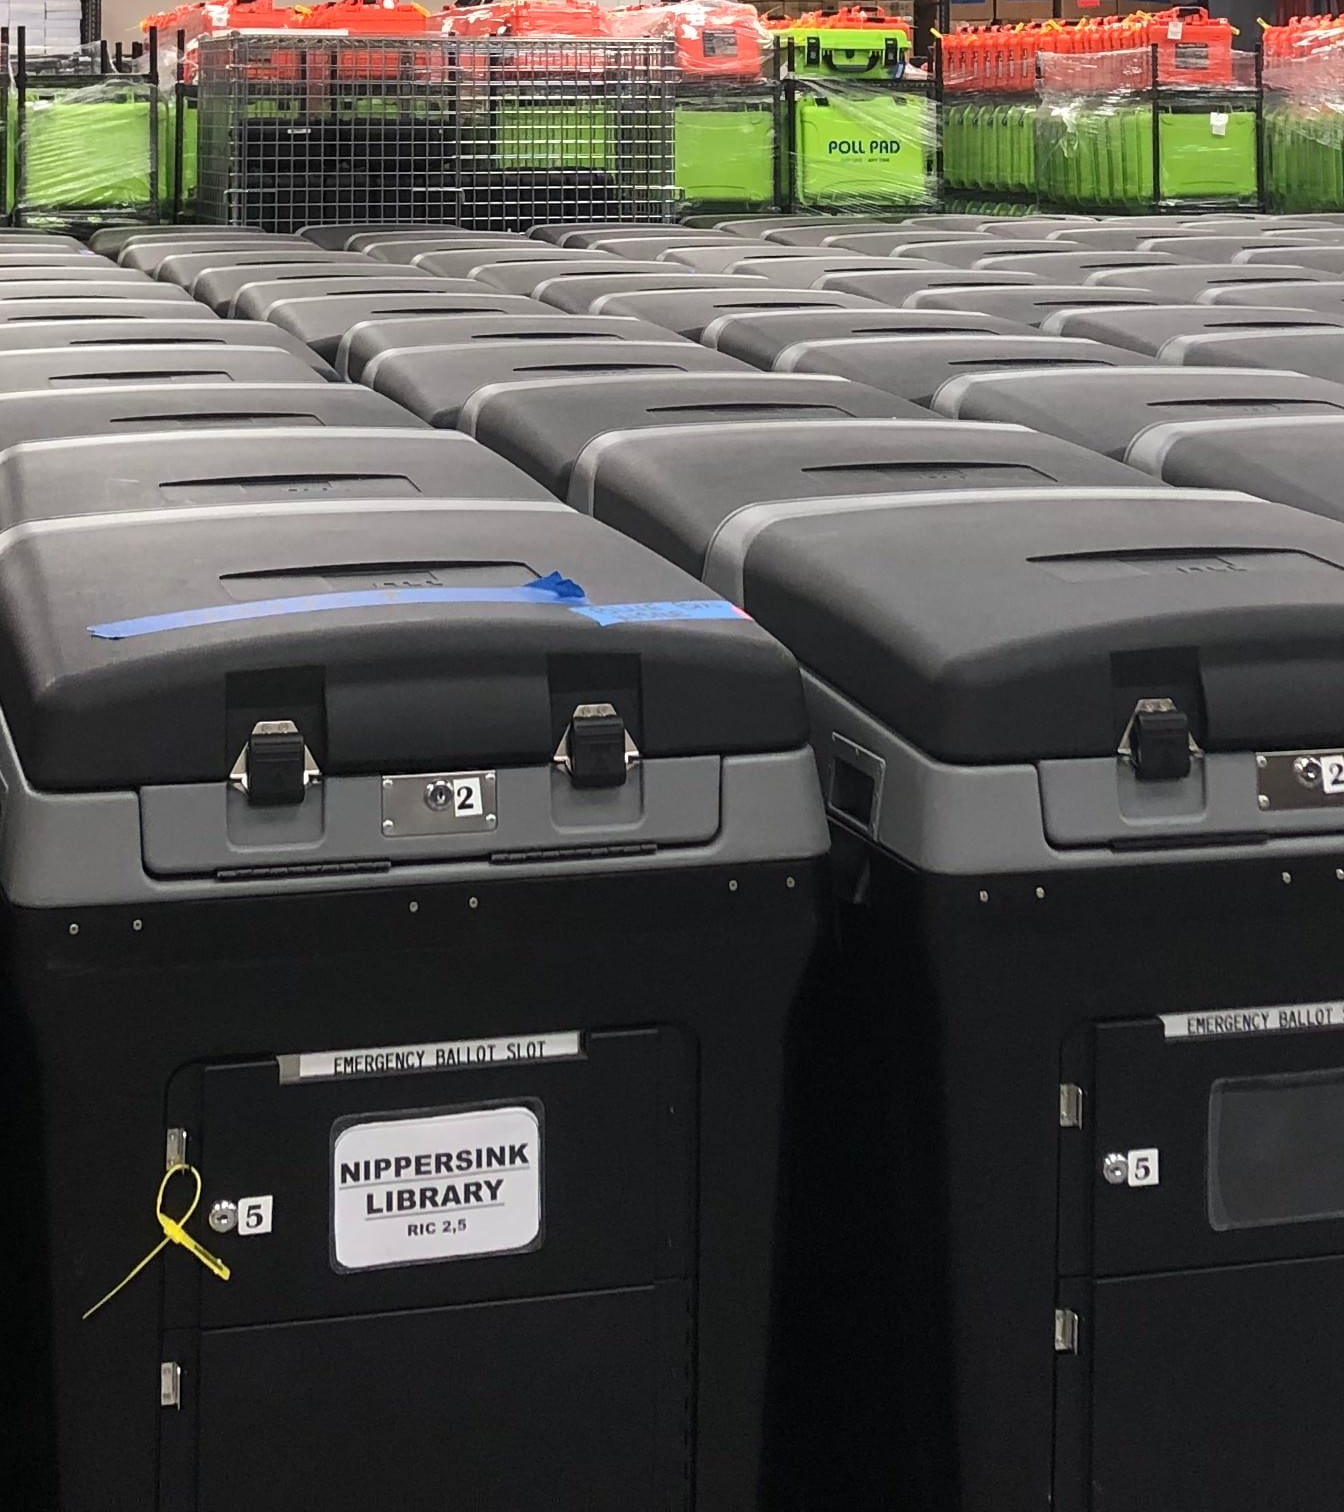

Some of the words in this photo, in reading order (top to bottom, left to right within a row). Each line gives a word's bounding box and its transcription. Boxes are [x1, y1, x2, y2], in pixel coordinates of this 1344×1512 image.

[828, 140, 865, 154] POLL
[869, 140, 900, 154] PAD
[1329, 763, 1344, 786] 2
[457, 786, 474, 810] 2
[1187, 1012, 1269, 1035] EMERGENCY
[1279, 1007, 1334, 1029] BALLOT
[333, 1050, 425, 1075] EMERGENCY
[436, 1044, 496, 1066] BALLOT
[507, 1040, 546, 1060] SLOT
[340, 1142, 529, 1184] NIPPERSINK
[1134, 1157, 1151, 1181] 5
[366, 1179, 504, 1215] LIBRARY
[246, 1204, 263, 1229] 5
[407, 1221, 436, 1237] RIC
[442, 1218, 467, 1235] 2,5
